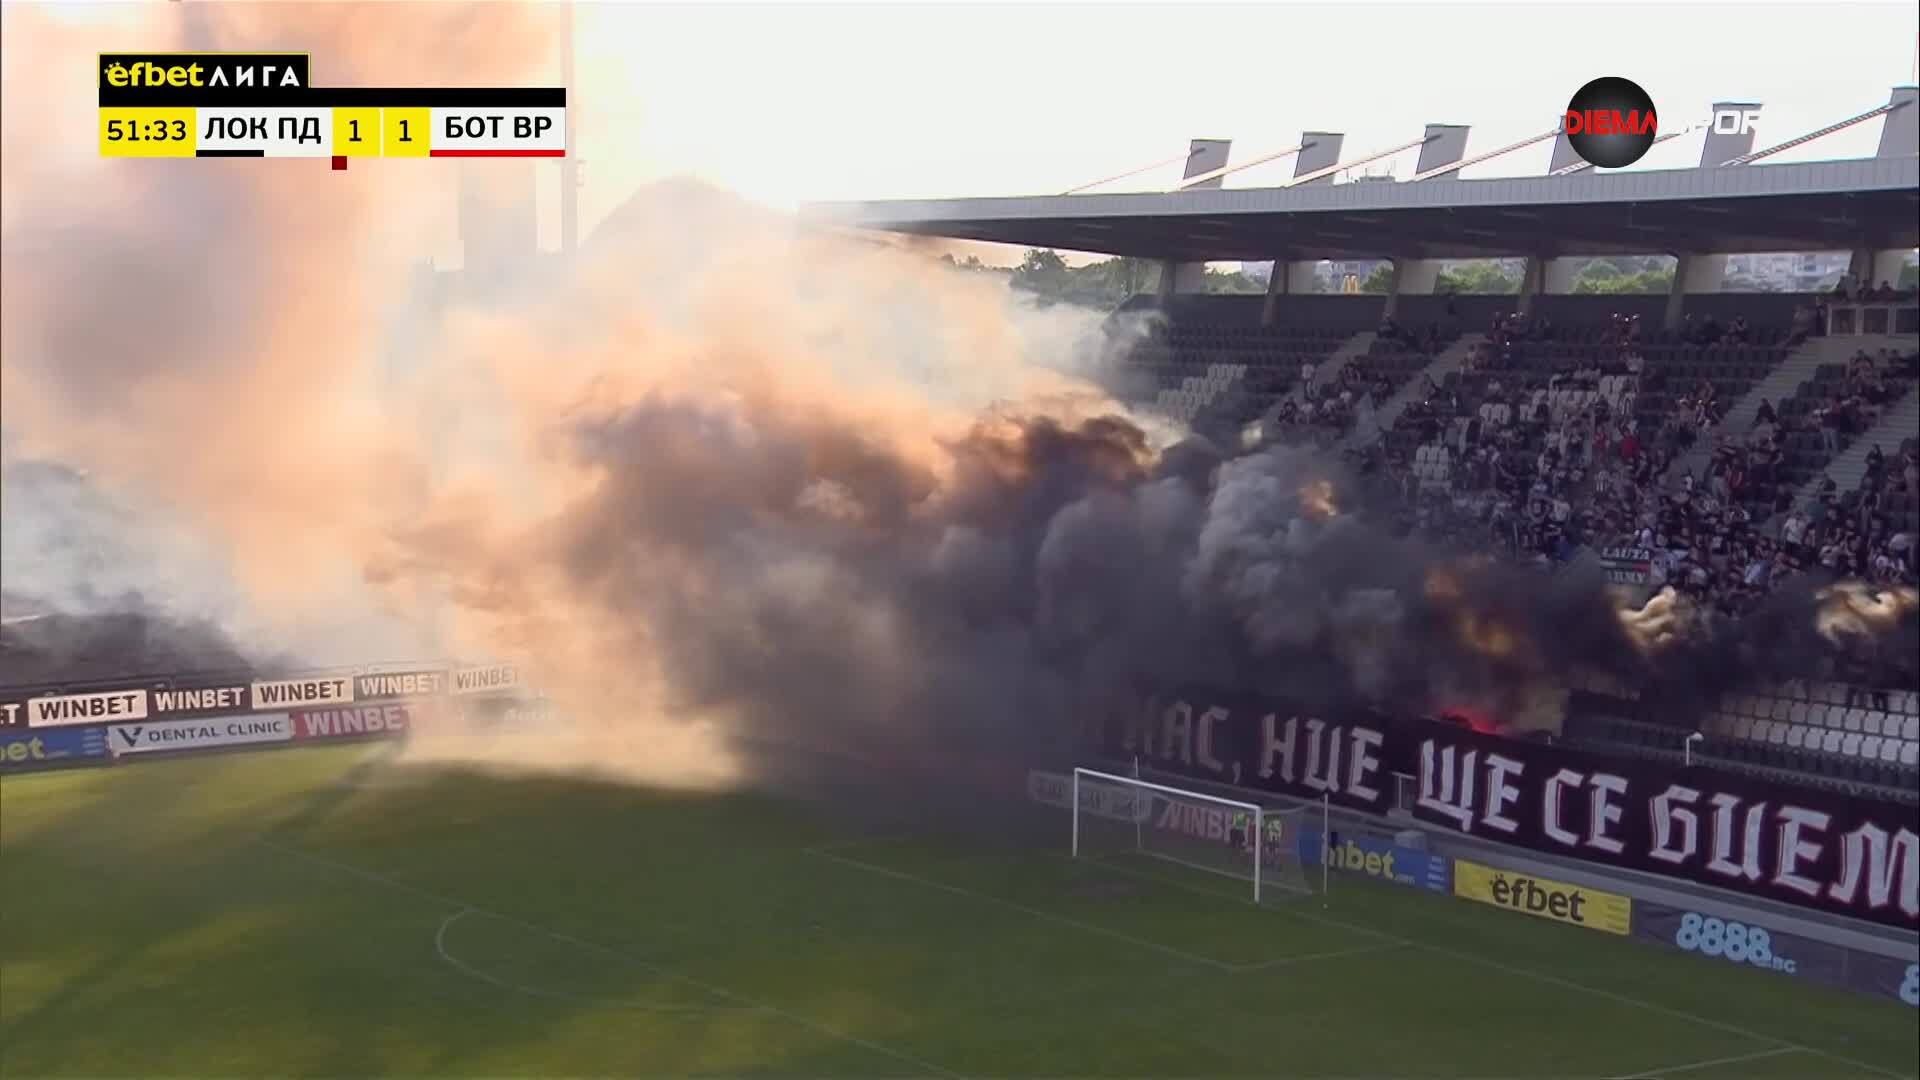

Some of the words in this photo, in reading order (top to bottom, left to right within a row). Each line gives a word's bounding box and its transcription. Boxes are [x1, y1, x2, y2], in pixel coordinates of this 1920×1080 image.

[259, 680, 345, 704] WINBET
[360, 672, 442, 697] WINBET
[38, 695, 138, 720] WINBET
[155, 687, 245, 712] WINBET
[148, 726, 221, 742] DENTAL
[227, 720, 284, 736] CLINIC
[1543, 767, 1629, 854] СЕ
